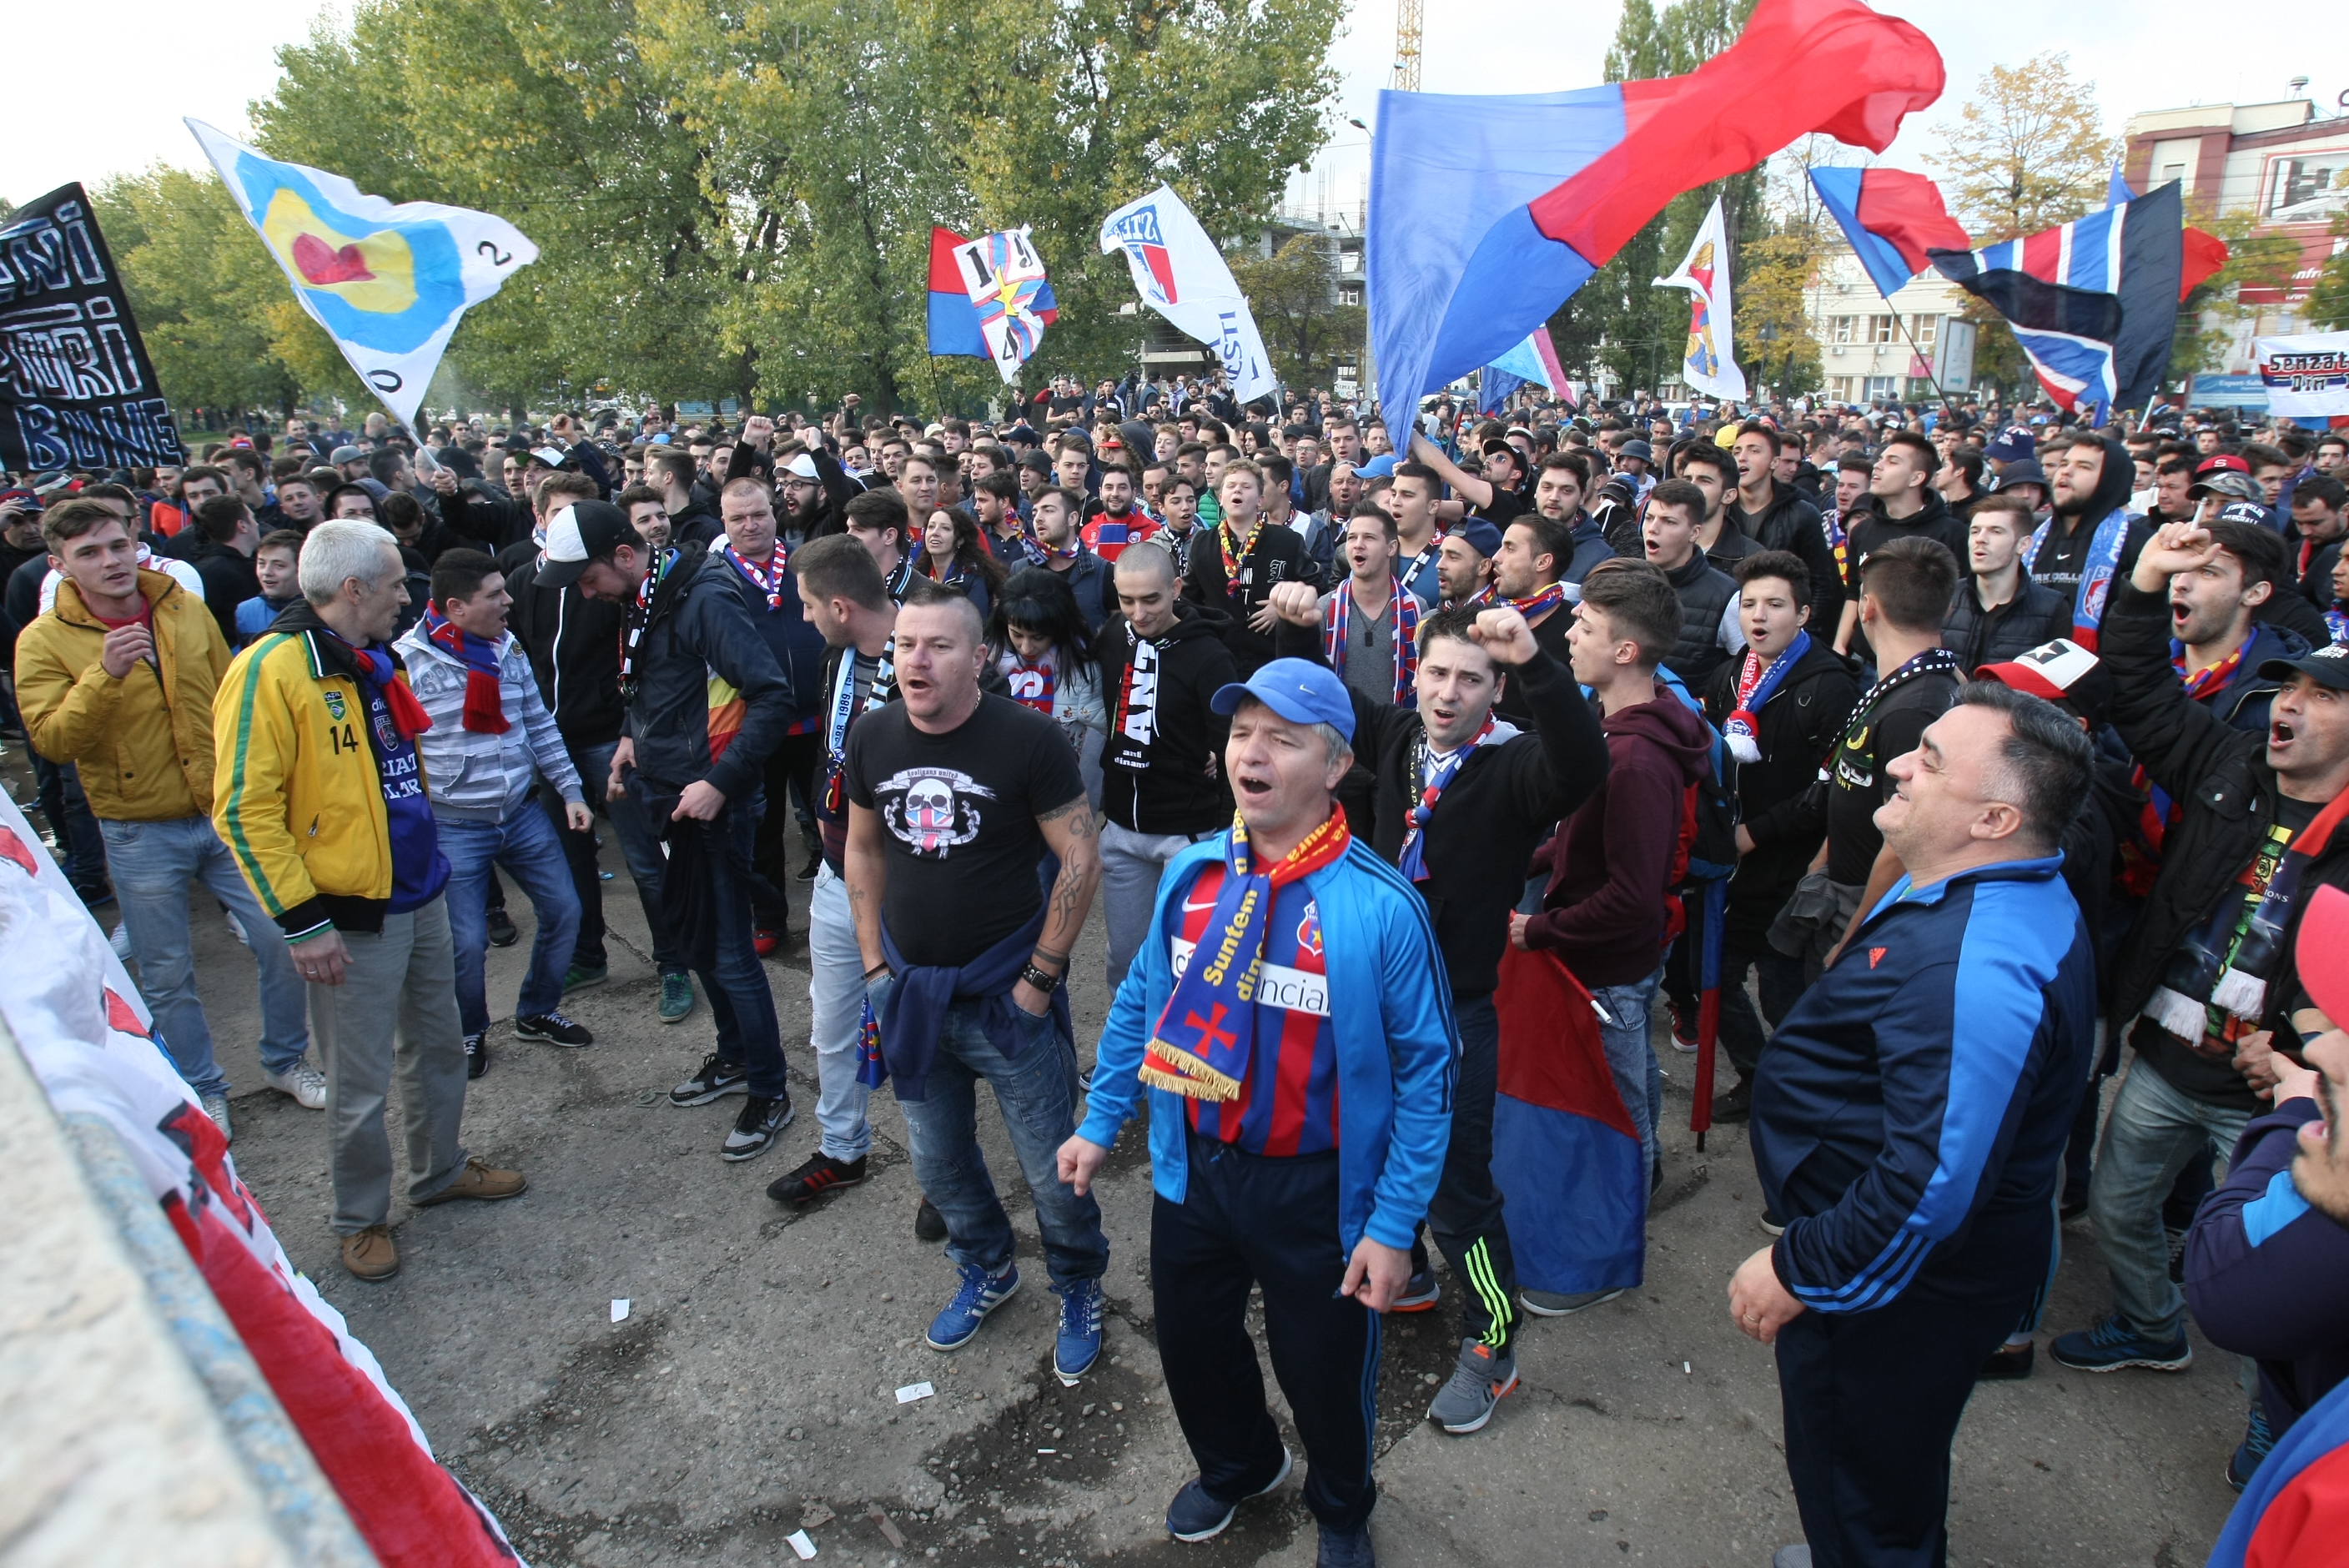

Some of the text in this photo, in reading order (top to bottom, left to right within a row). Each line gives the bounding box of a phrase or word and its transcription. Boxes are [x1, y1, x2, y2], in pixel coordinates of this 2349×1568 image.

[477, 240, 513, 267] 2
[15, 397, 184, 470] BUNE
[2213, 459, 2227, 468] S
[2225, 502, 2266, 519] FRANKLIN
[1115, 662, 1134, 733] NASCUT
[329, 723, 359, 756] 14
[1114, 756, 1150, 769] dinamo
[1123, 750, 1142, 759] anti
[907, 768, 958, 779] hooligans united
[1203, 889, 1258, 987] Suntem
